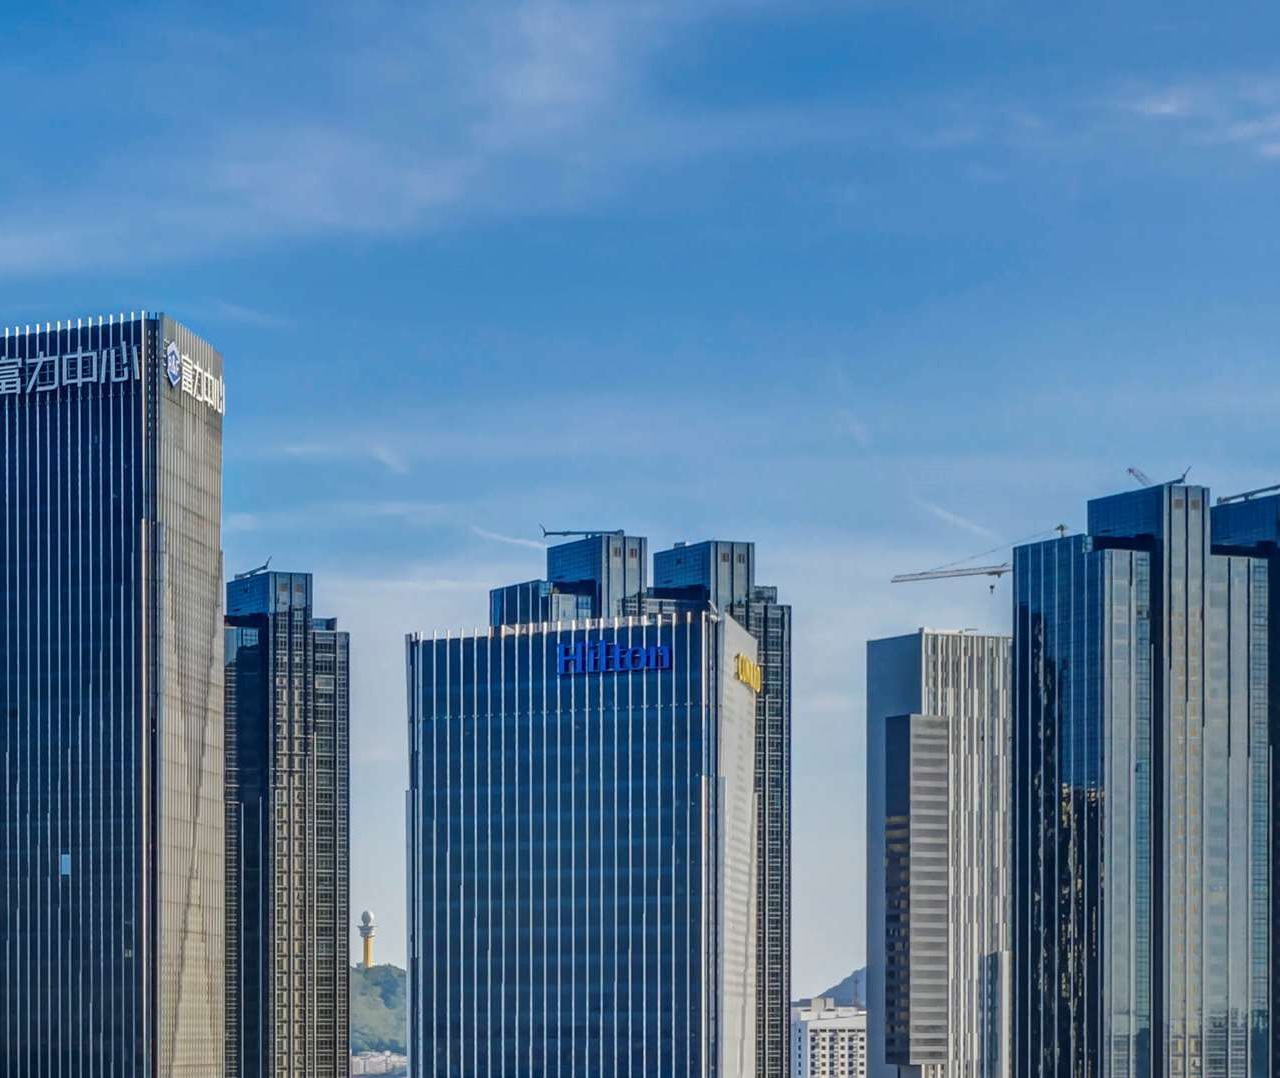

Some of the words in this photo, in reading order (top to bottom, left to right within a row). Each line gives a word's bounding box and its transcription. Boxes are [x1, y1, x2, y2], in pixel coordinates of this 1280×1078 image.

[181, 354, 225, 416] 富力中心
[557, 639, 671, 675] Hilton
